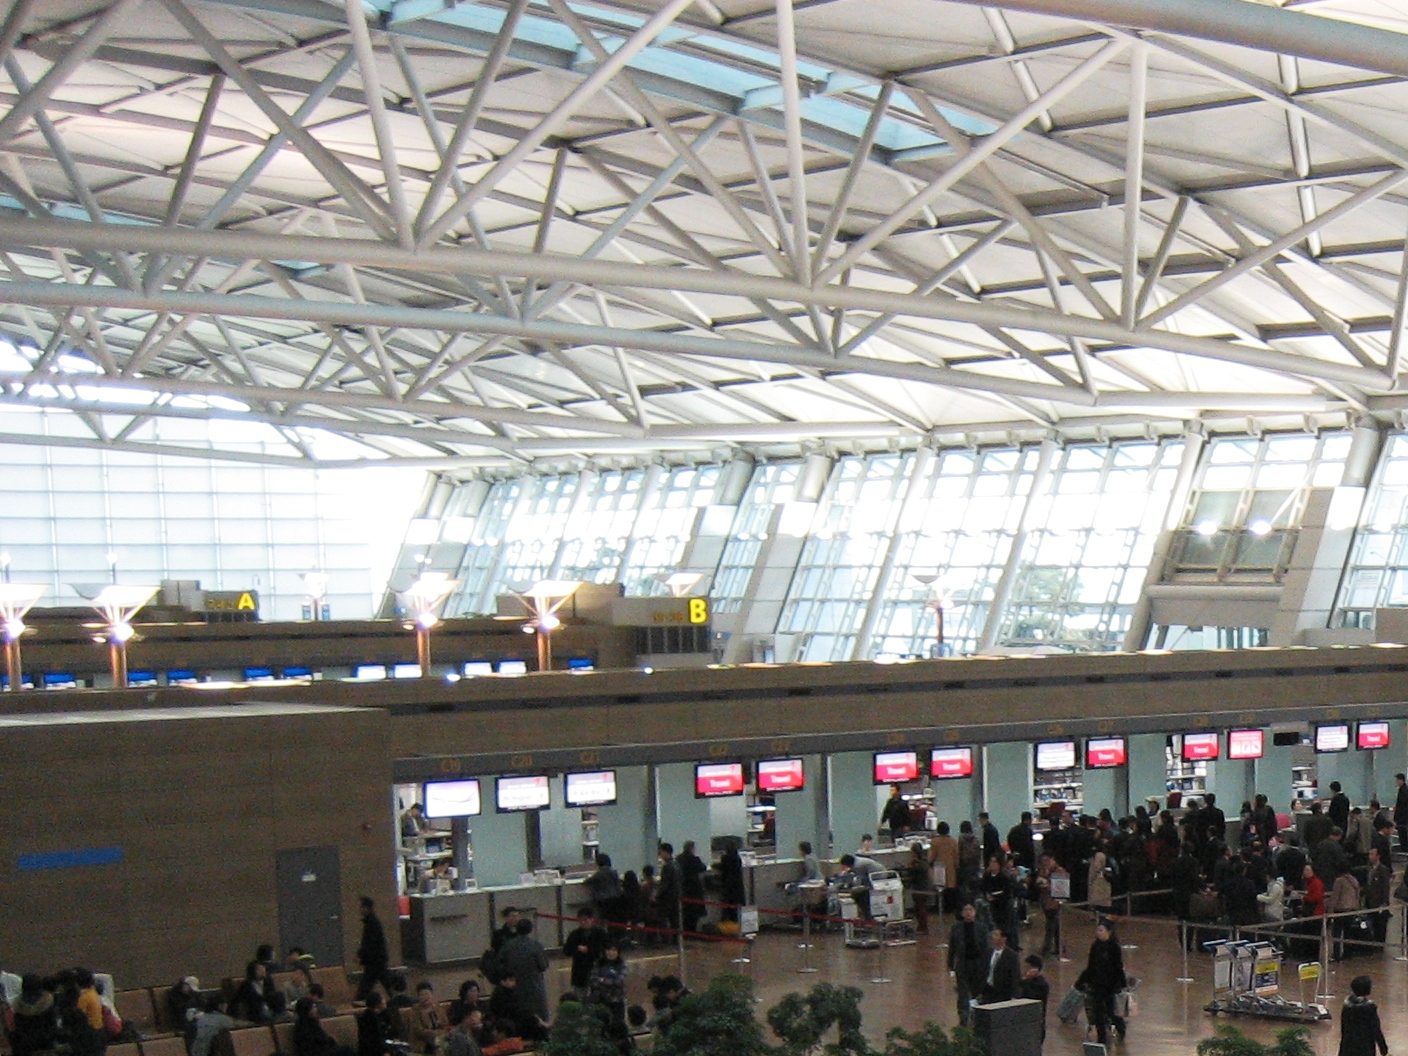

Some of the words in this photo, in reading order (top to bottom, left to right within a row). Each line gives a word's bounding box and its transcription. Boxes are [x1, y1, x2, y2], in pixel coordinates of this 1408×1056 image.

[238, 592, 255, 610] A
[689, 598, 707, 624] B
[709, 778, 731, 789] Travel
[770, 774, 791, 784] Travel
